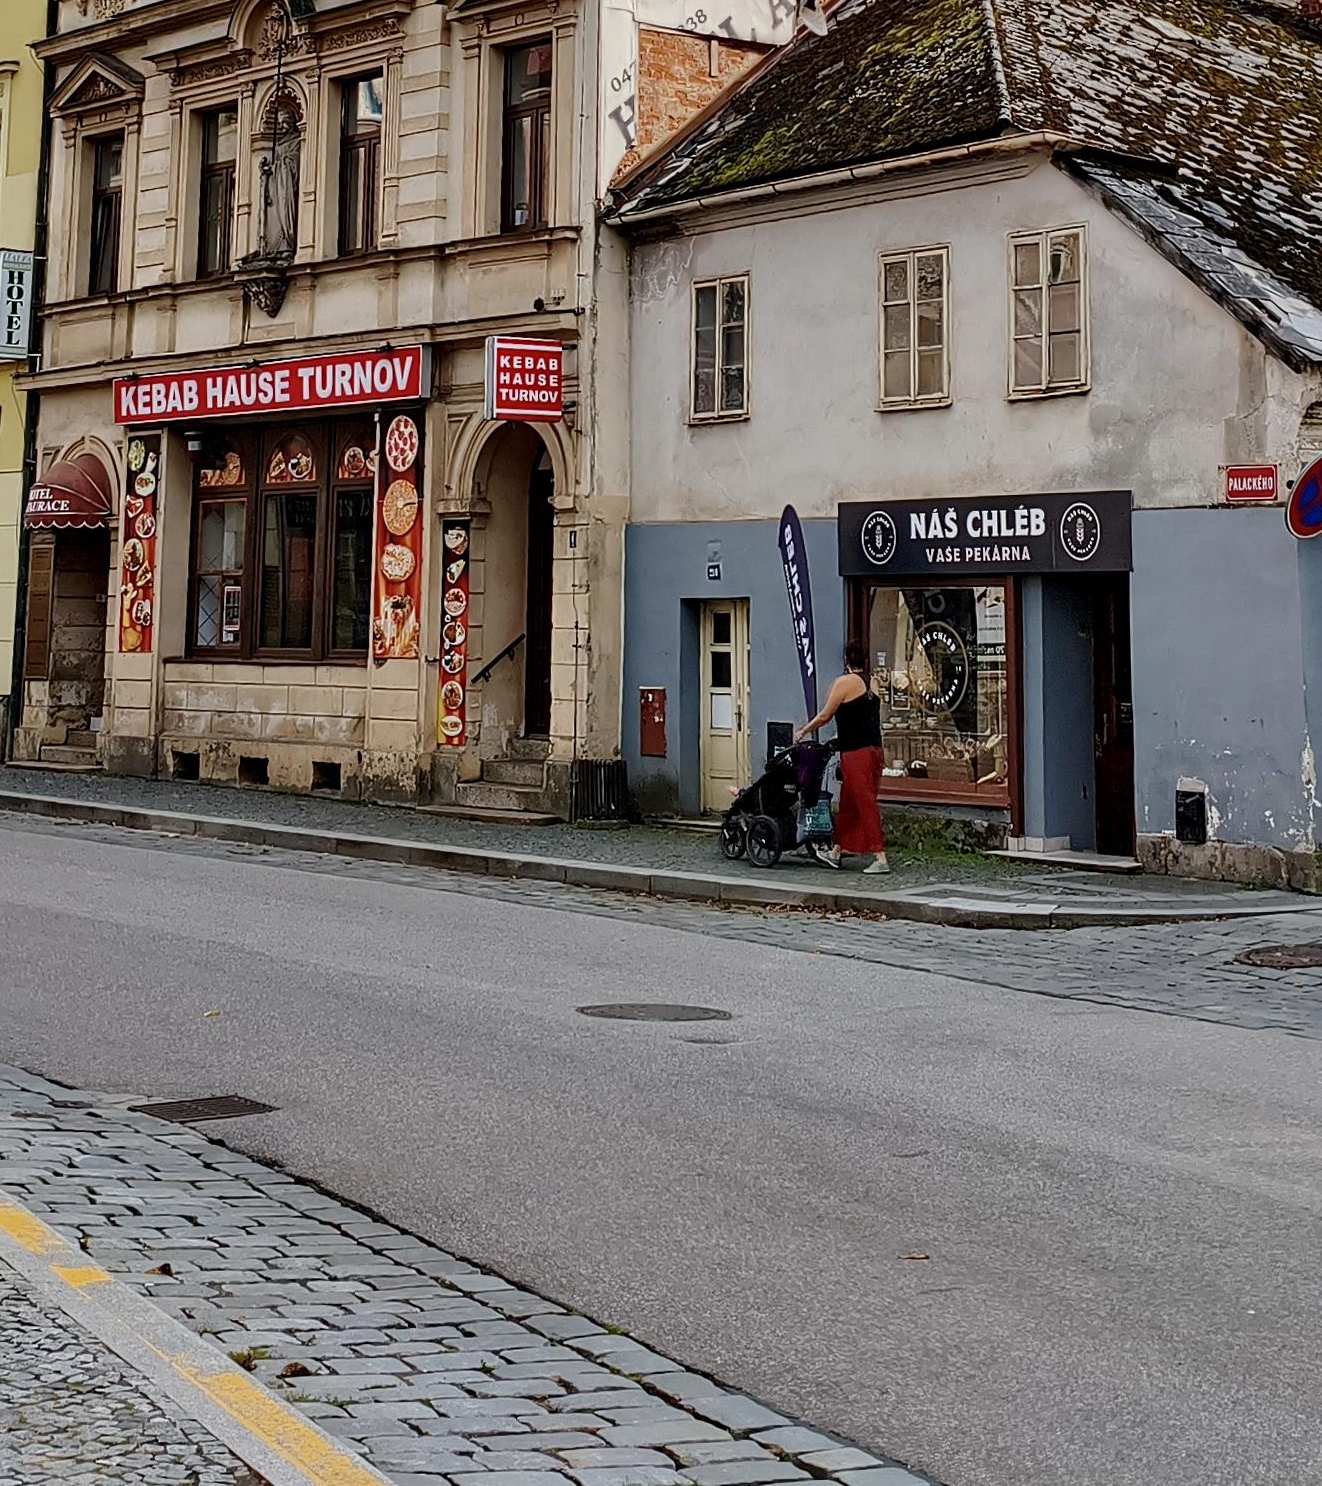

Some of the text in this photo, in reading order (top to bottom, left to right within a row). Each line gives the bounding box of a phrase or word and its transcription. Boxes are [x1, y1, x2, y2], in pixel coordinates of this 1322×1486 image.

[6, 270, 24, 345] HOTEL
[499, 355, 558, 371] KEBAB
[120, 356, 414, 417] KEBAB HAUSE TURNOV
[499, 372, 559, 387] HAUSE
[499, 388, 559, 403] TURNOV
[1229, 475, 1273, 492] PALACKÉHO
[29, 488, 53, 501] OTEL
[909, 503, 1046, 540] NÁŠ CHLÉB
[925, 544, 1031, 563] VAŠE PEKÁRNA
